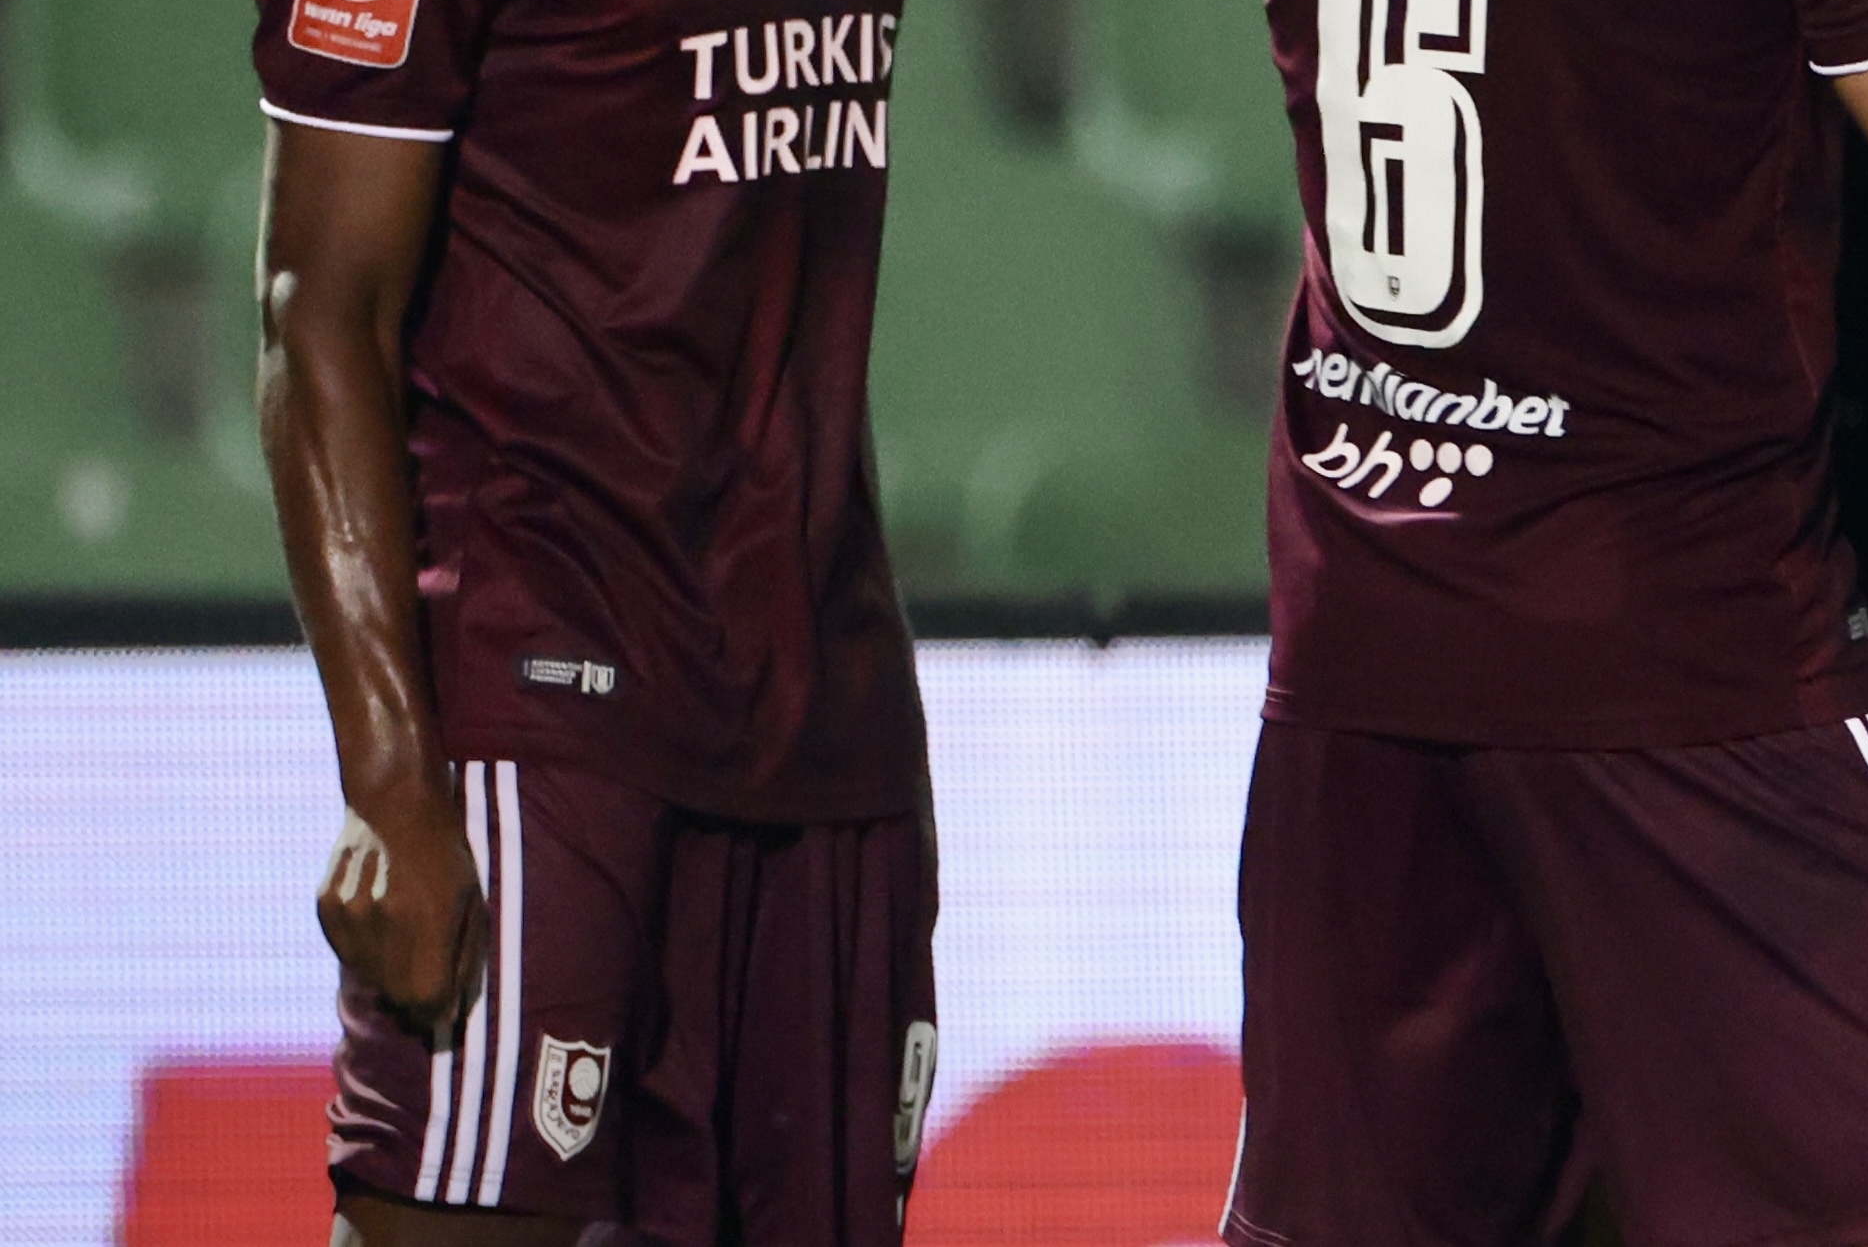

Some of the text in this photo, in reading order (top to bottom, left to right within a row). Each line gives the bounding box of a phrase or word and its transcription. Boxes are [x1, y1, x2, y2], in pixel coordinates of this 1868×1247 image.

[354, 12, 398, 39] liga
[673, 100, 887, 185] AIRLIN
[1301, 423, 1403, 499] bh
